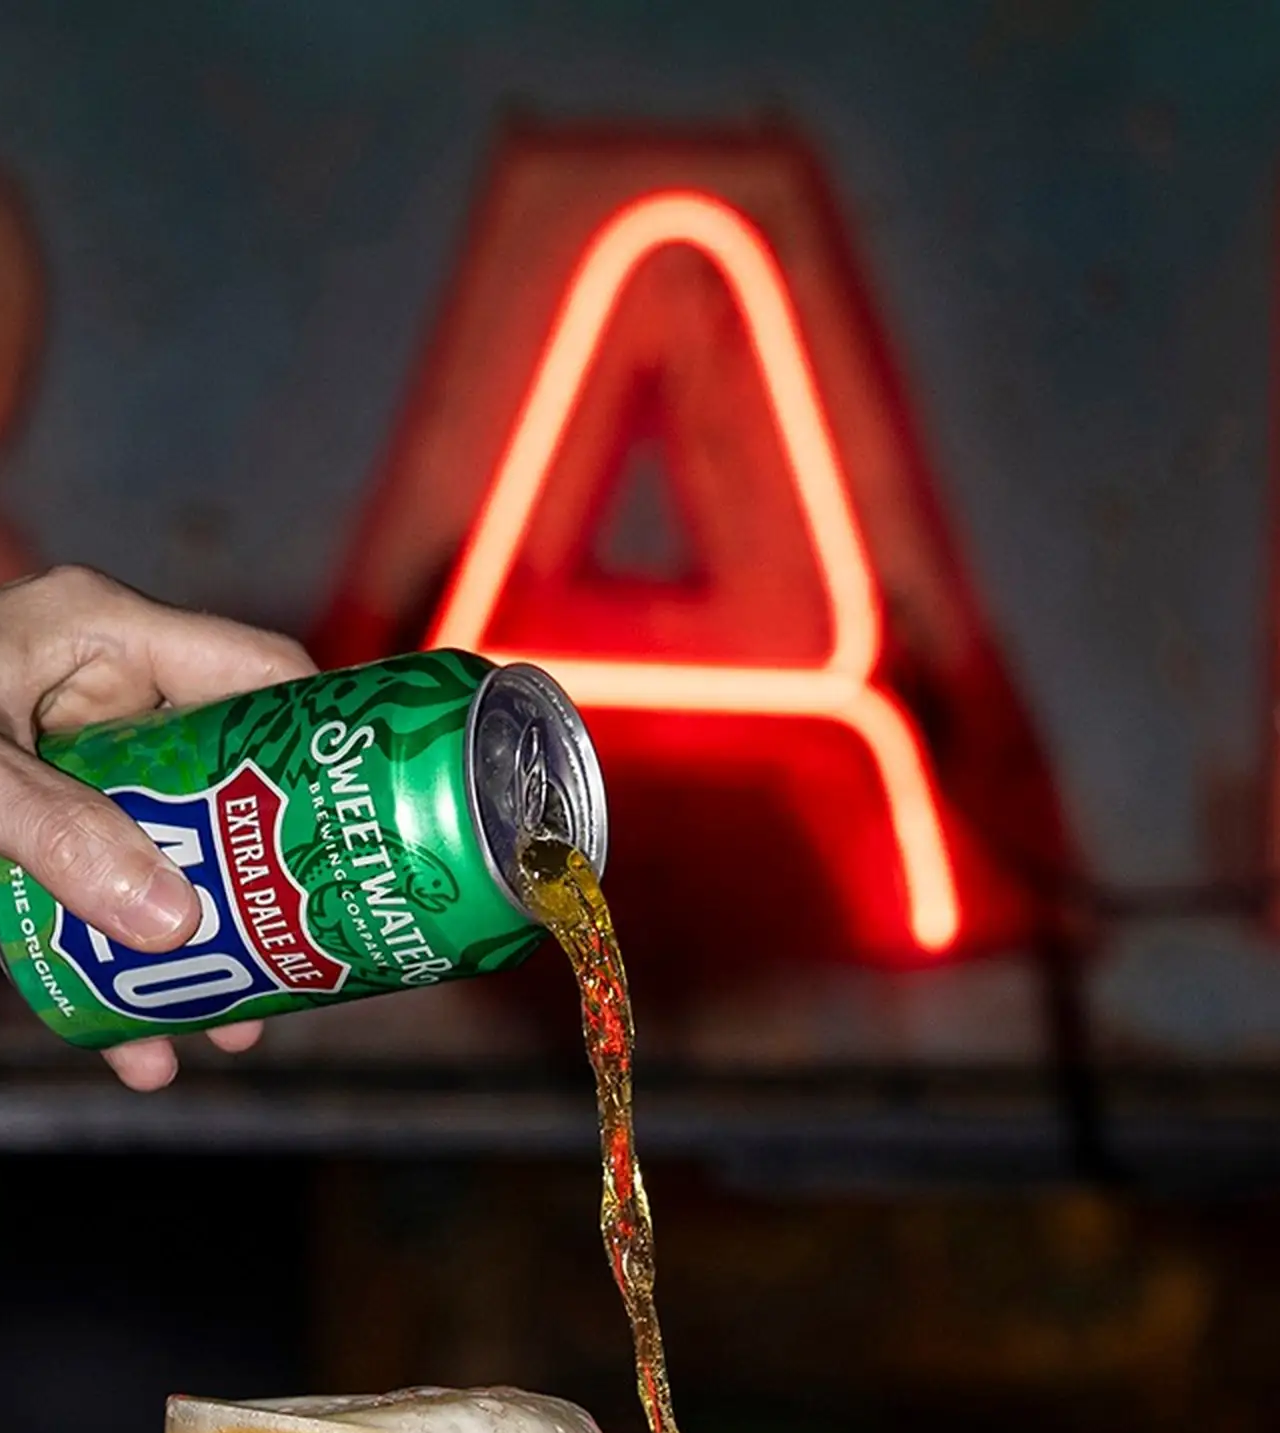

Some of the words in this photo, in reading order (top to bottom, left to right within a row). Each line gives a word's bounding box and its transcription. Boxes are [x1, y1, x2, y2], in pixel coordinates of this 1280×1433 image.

[224, 794, 270, 885] EXTRA
[308, 781, 347, 881] BREWING
[341, 889, 390, 969] COMPANY
[9, 865, 32, 915] THE
[243, 886, 297, 950] PALE
[20, 917, 76, 1018] ORIGINAL
[270, 951, 323, 984] ALE
